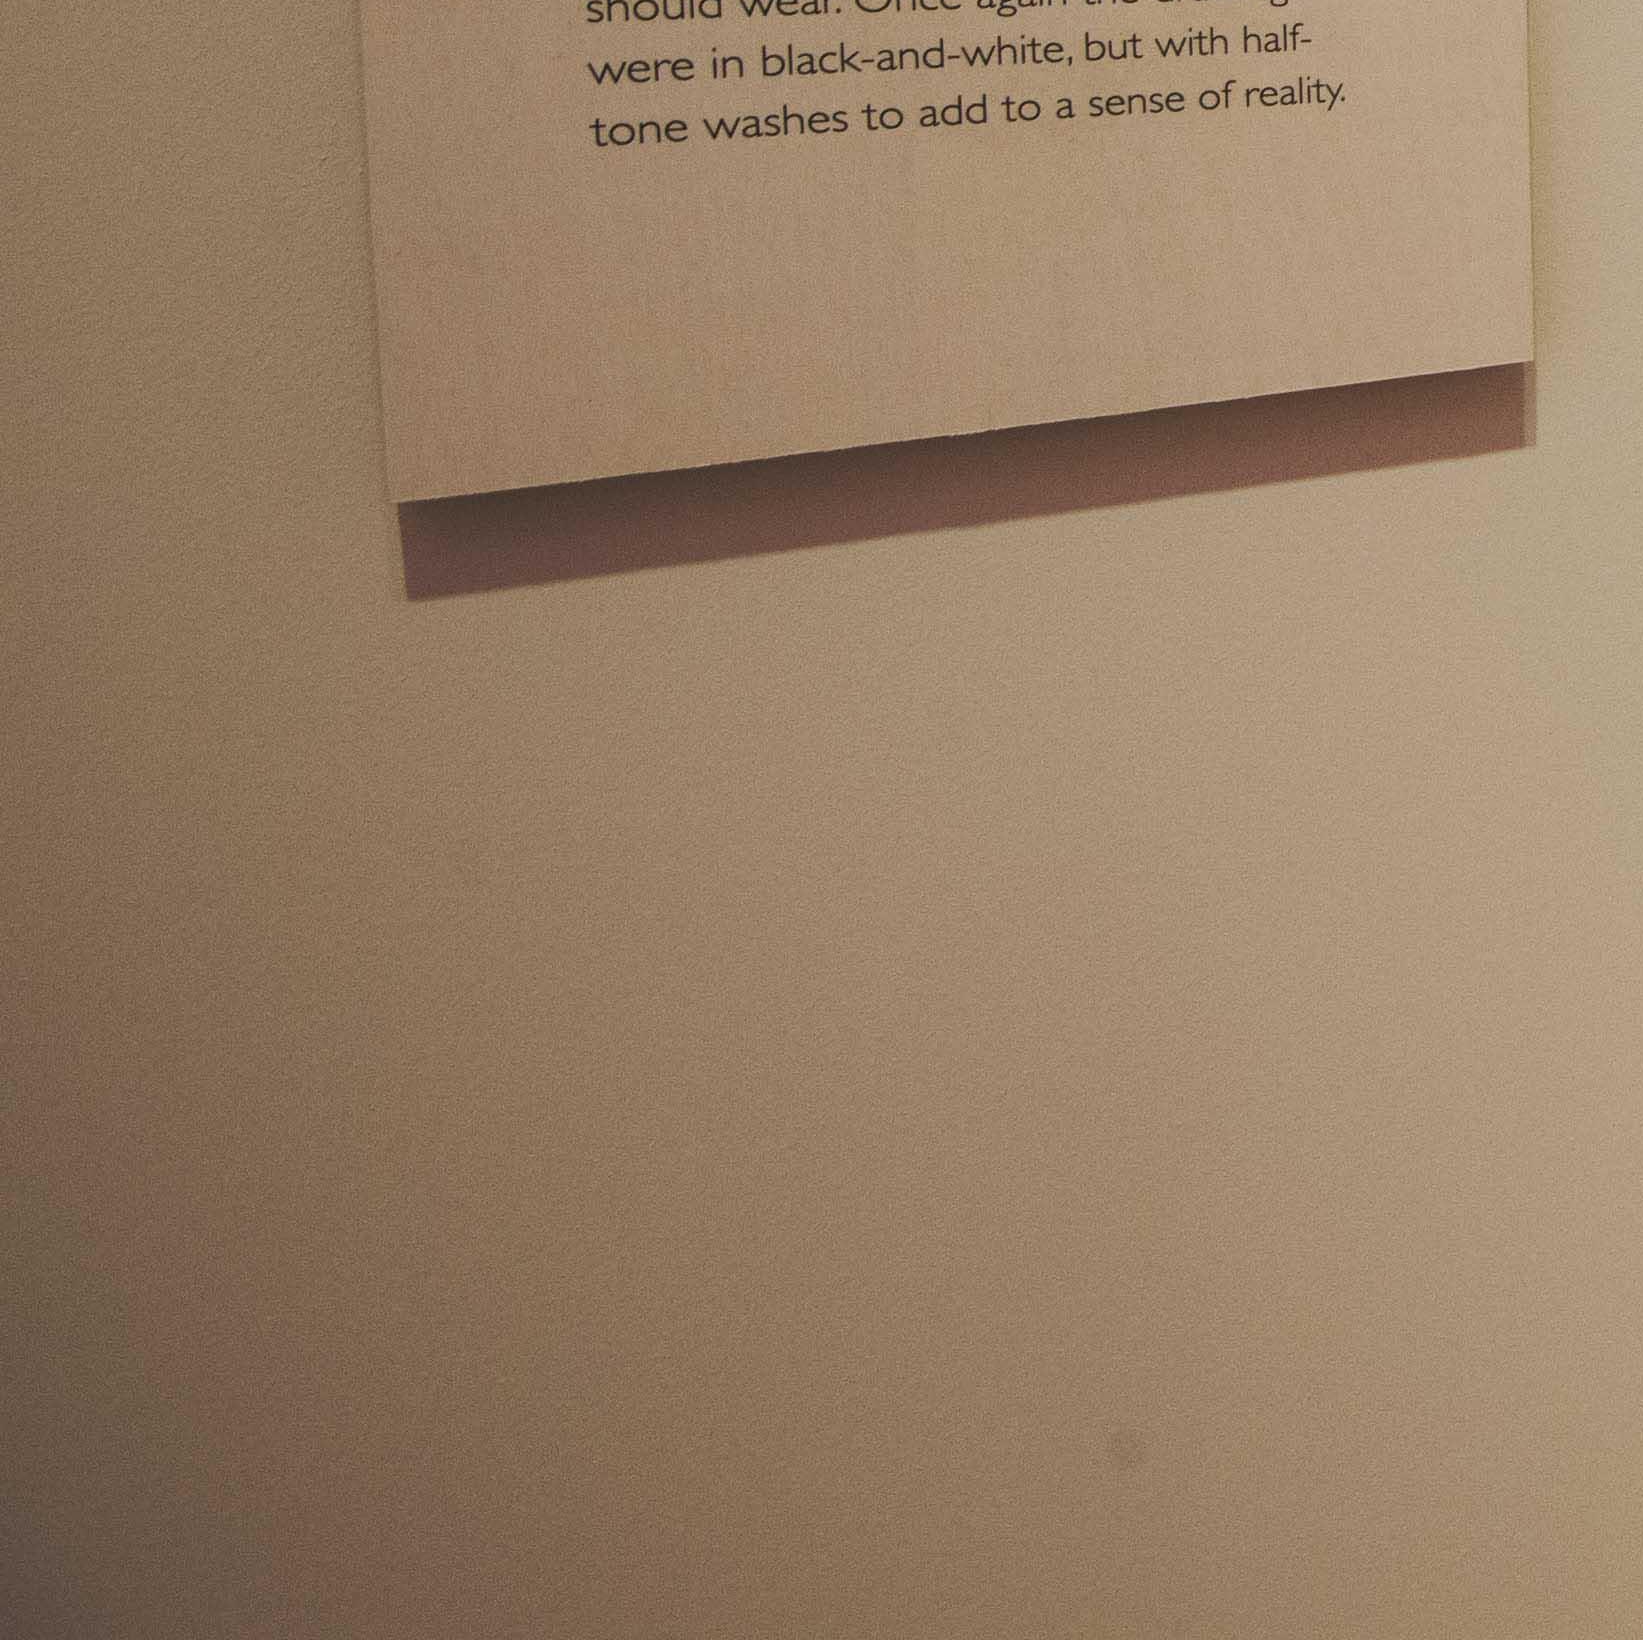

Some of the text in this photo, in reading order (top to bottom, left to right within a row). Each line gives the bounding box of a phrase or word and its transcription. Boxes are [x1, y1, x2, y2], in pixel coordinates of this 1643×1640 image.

[586, 22, 1313, 86] were in black-and-white, but with half-
[588, 75, 1346, 148] tone washes to add to a sense of reality.
